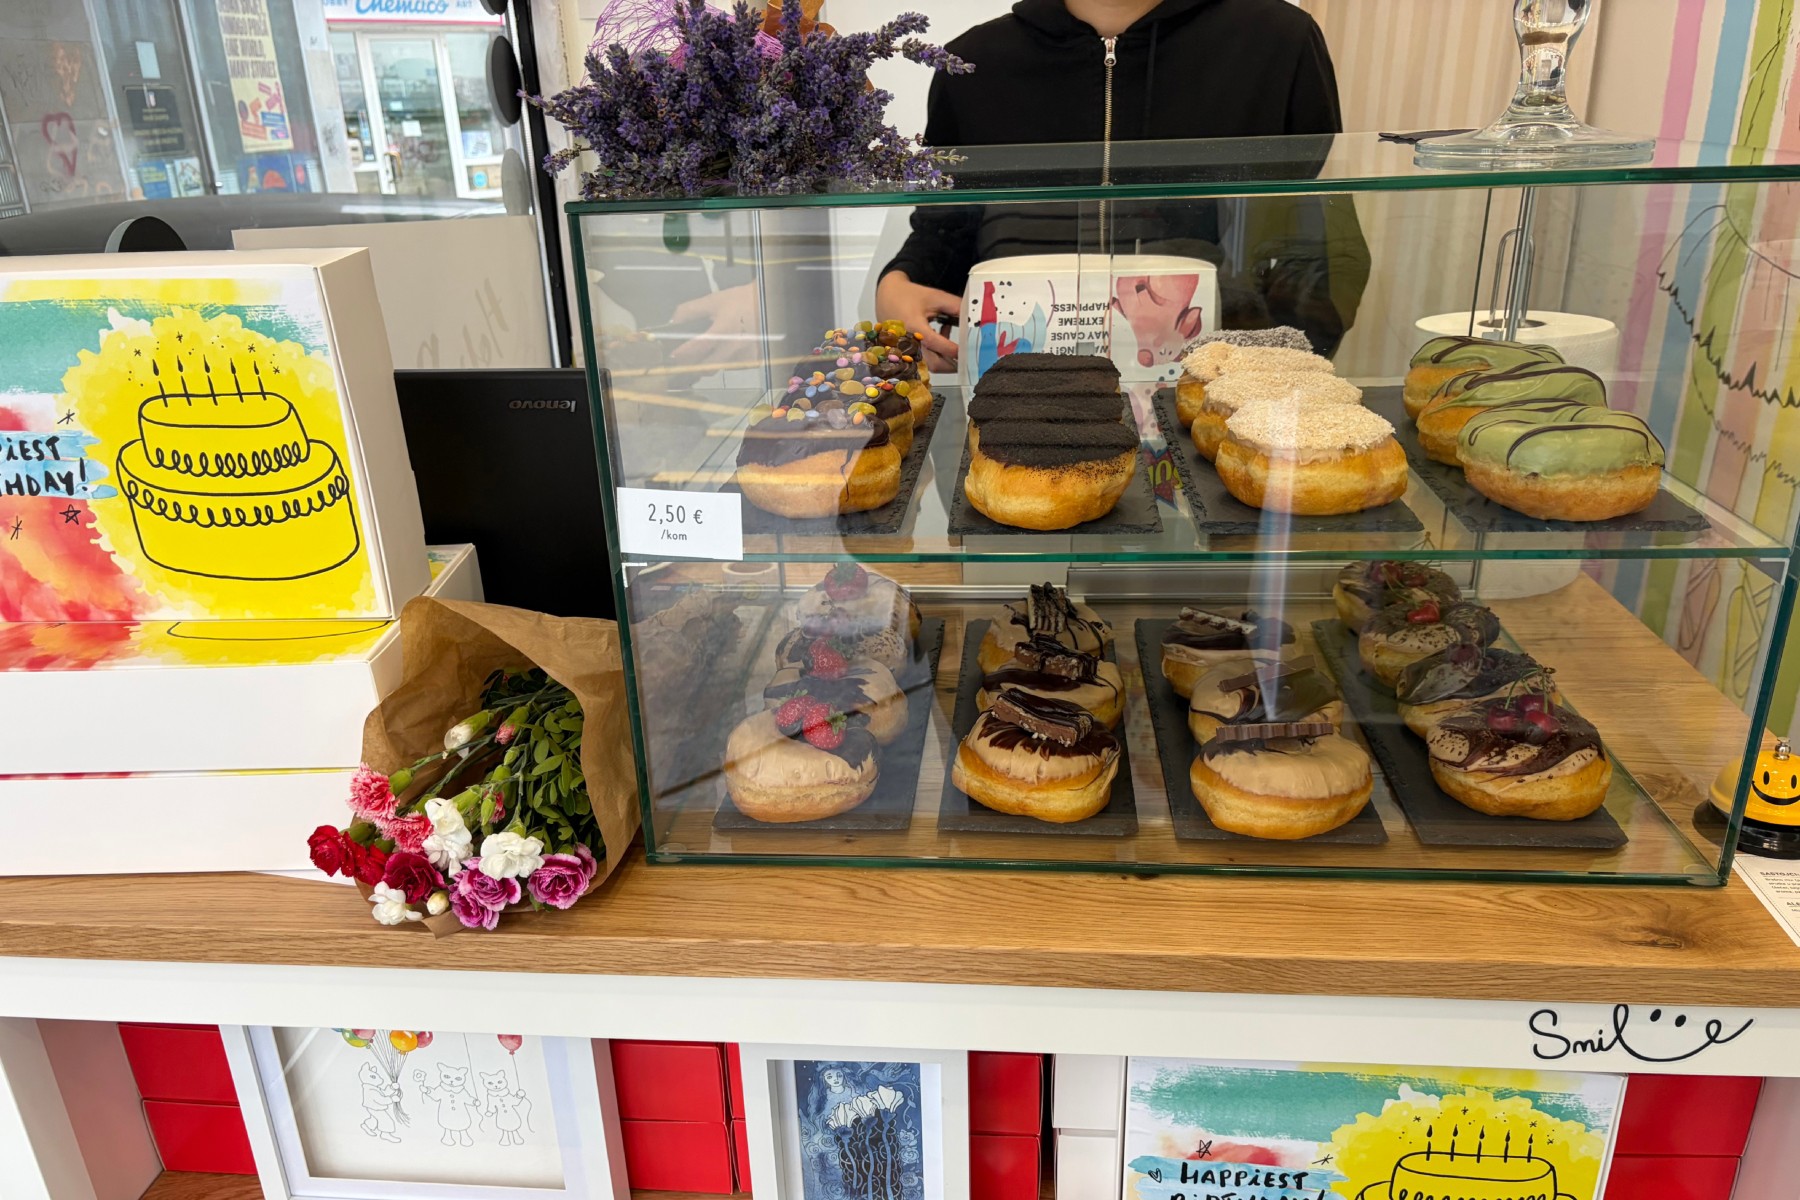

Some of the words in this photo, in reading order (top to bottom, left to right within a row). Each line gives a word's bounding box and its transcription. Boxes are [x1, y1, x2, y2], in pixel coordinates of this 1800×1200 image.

[1058, 316, 1105, 327] EXTREME
[1051, 332, 1085, 341] CAUSE
[1088, 331, 1110, 340] MAY
[508, 400, 577, 413] lenovo
[0, 457, 88, 496] HDAY!
[648, 503, 686, 525] 2,50
[693, 509, 703, 525] €
[660, 529, 688, 541] /kom
[1529, 1003, 1754, 1062] Smile
